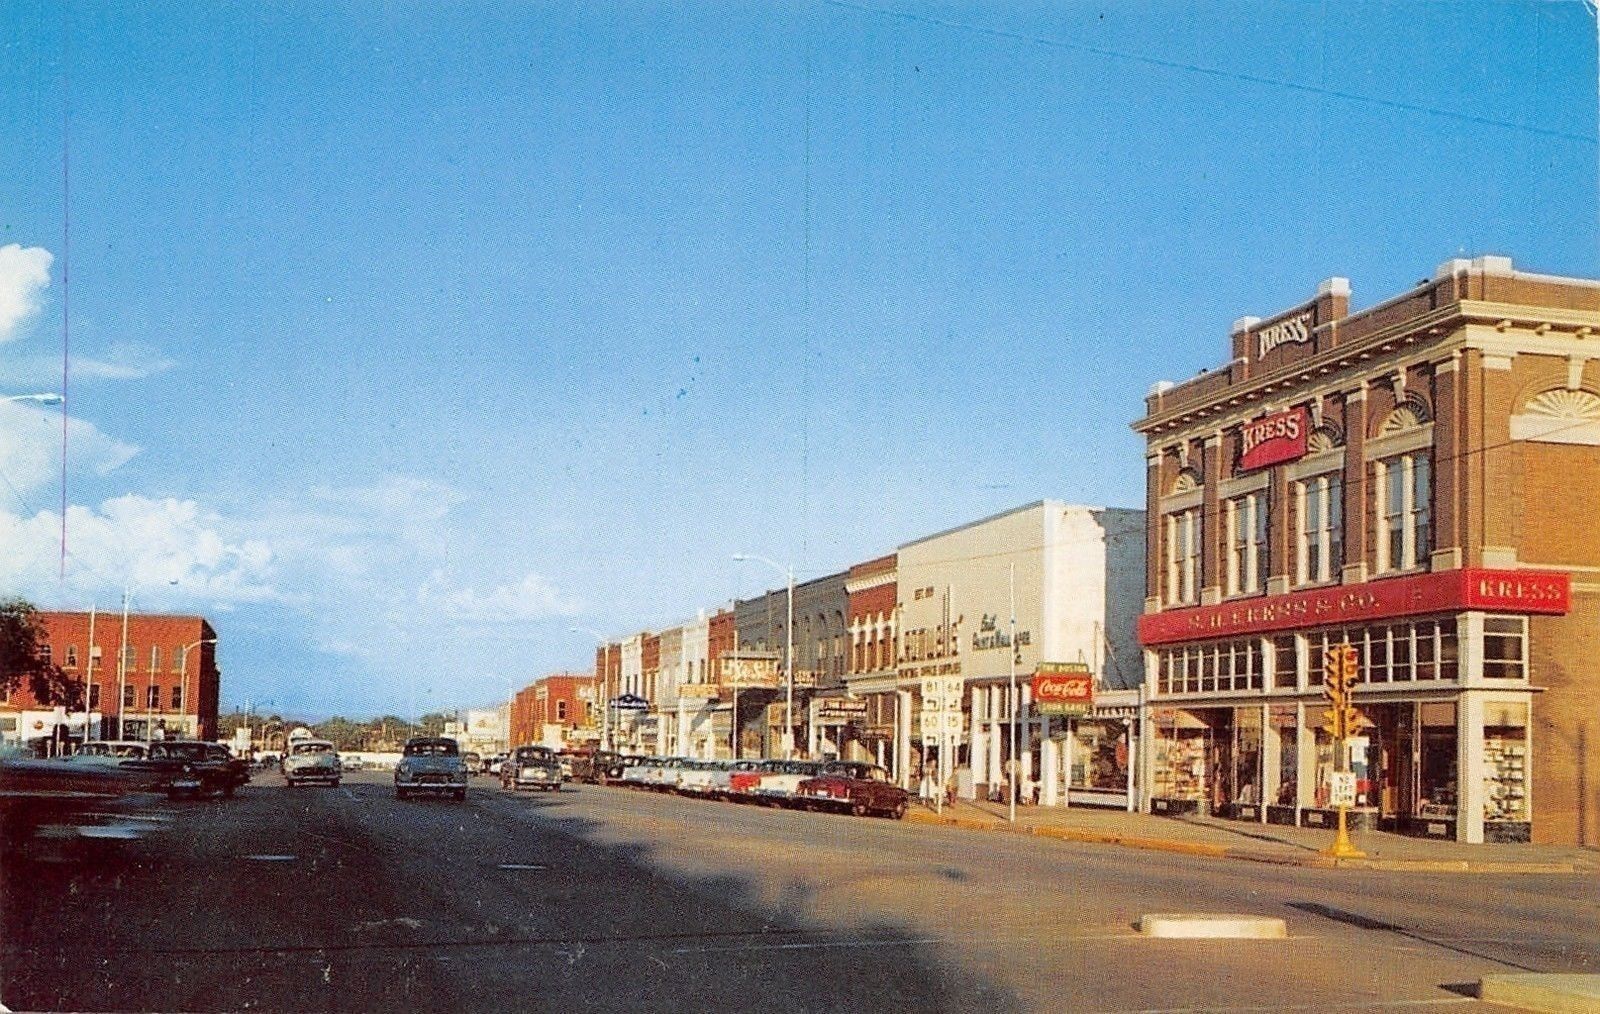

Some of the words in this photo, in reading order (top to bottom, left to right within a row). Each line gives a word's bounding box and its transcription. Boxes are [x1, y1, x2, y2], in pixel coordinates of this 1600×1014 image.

[1258, 313, 1311, 361] KRESS
[1242, 413, 1302, 457] KRESS
[1479, 580, 1561, 600] KRESS
[1039, 679, 1089, 698] Coca-Cola
